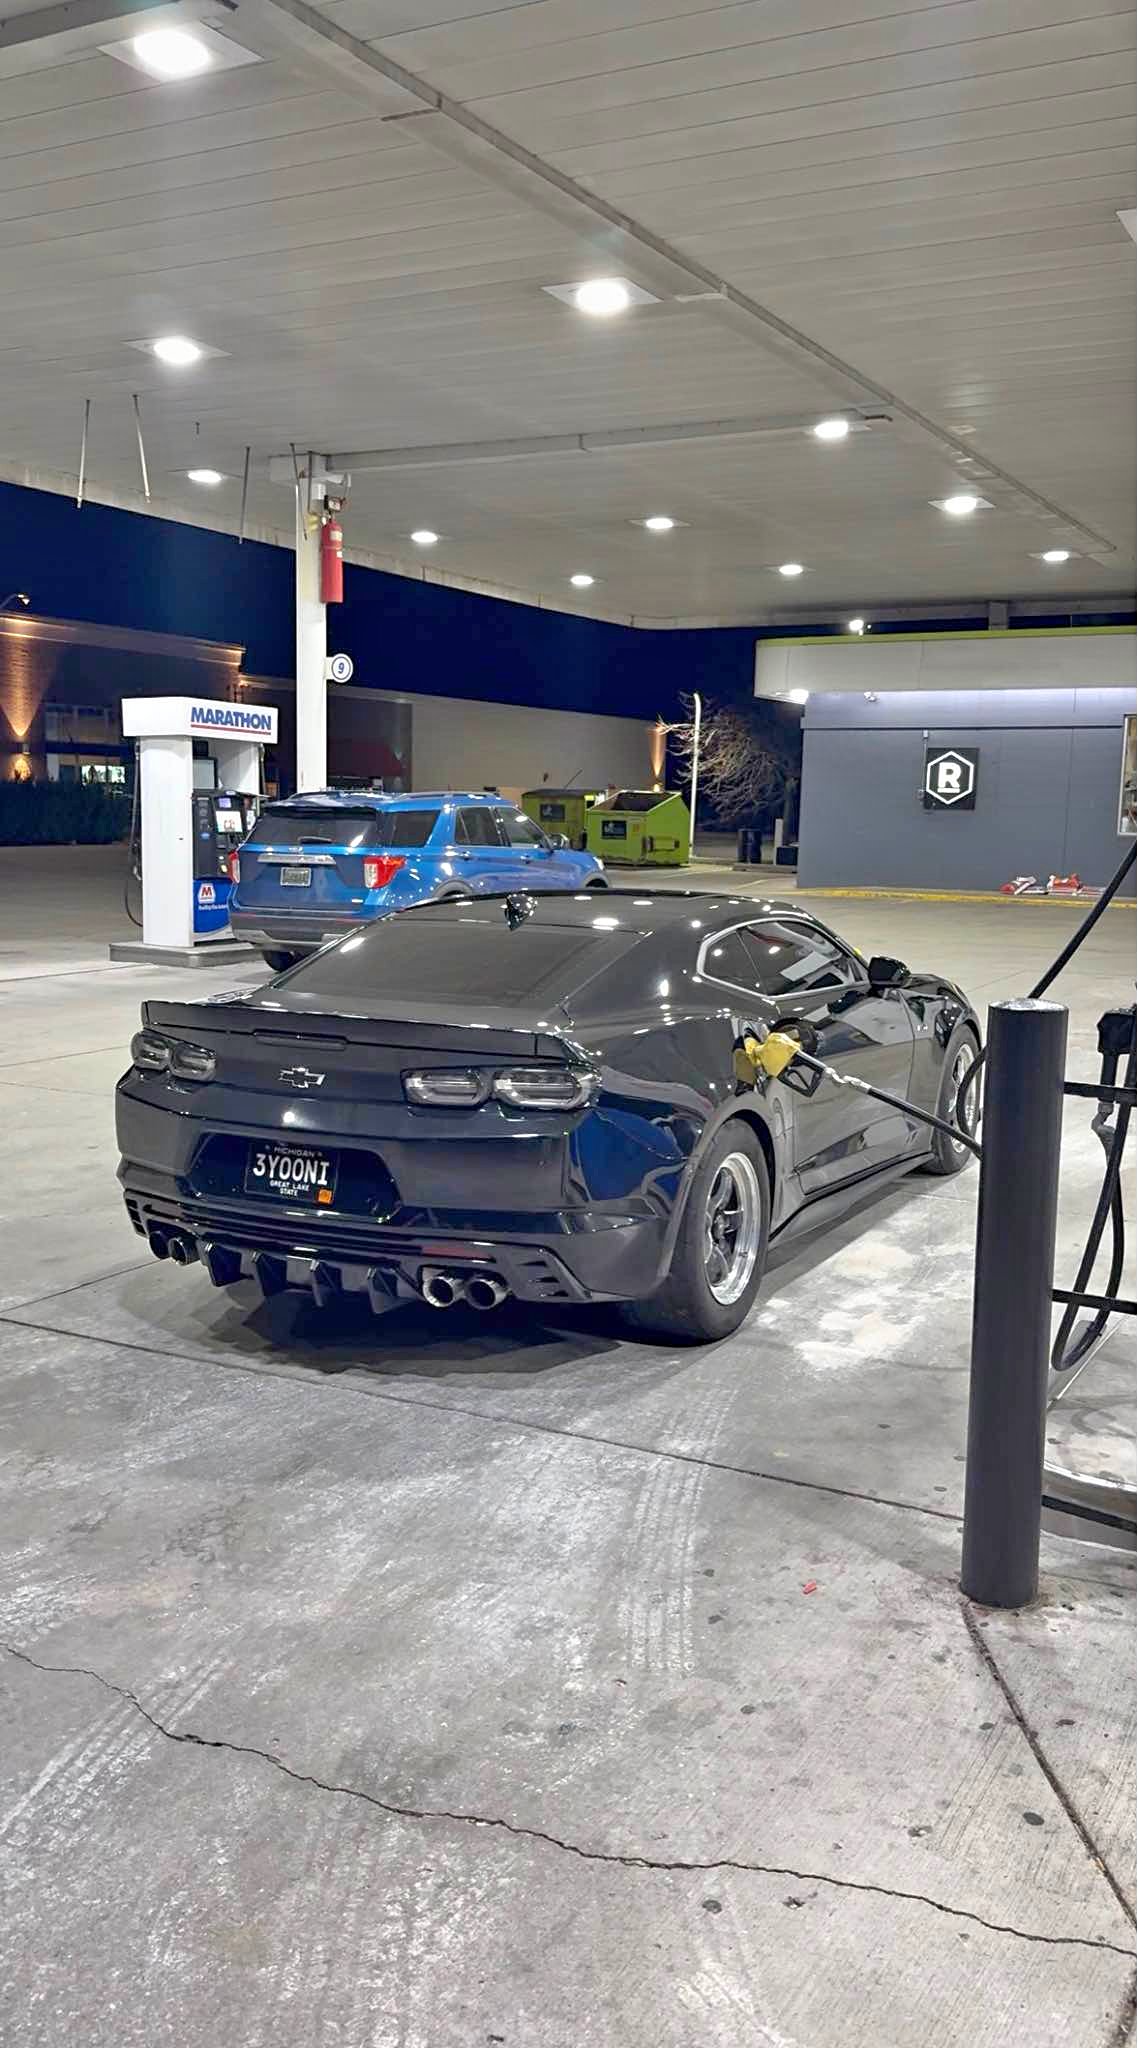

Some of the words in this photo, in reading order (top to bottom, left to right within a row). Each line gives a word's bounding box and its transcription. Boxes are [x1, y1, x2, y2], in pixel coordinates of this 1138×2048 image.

[337, 662, 345, 674] 9
[191, 706, 272, 731] MARATHON
[937, 761, 962, 789] R
[201, 886, 213, 897] M
[274, 1146, 315, 1158] MICHIGAN
[269, 1179, 290, 1189] GREAT
[292, 1183, 310, 1192] LAKE
[279, 1187, 298, 1197] STATE
